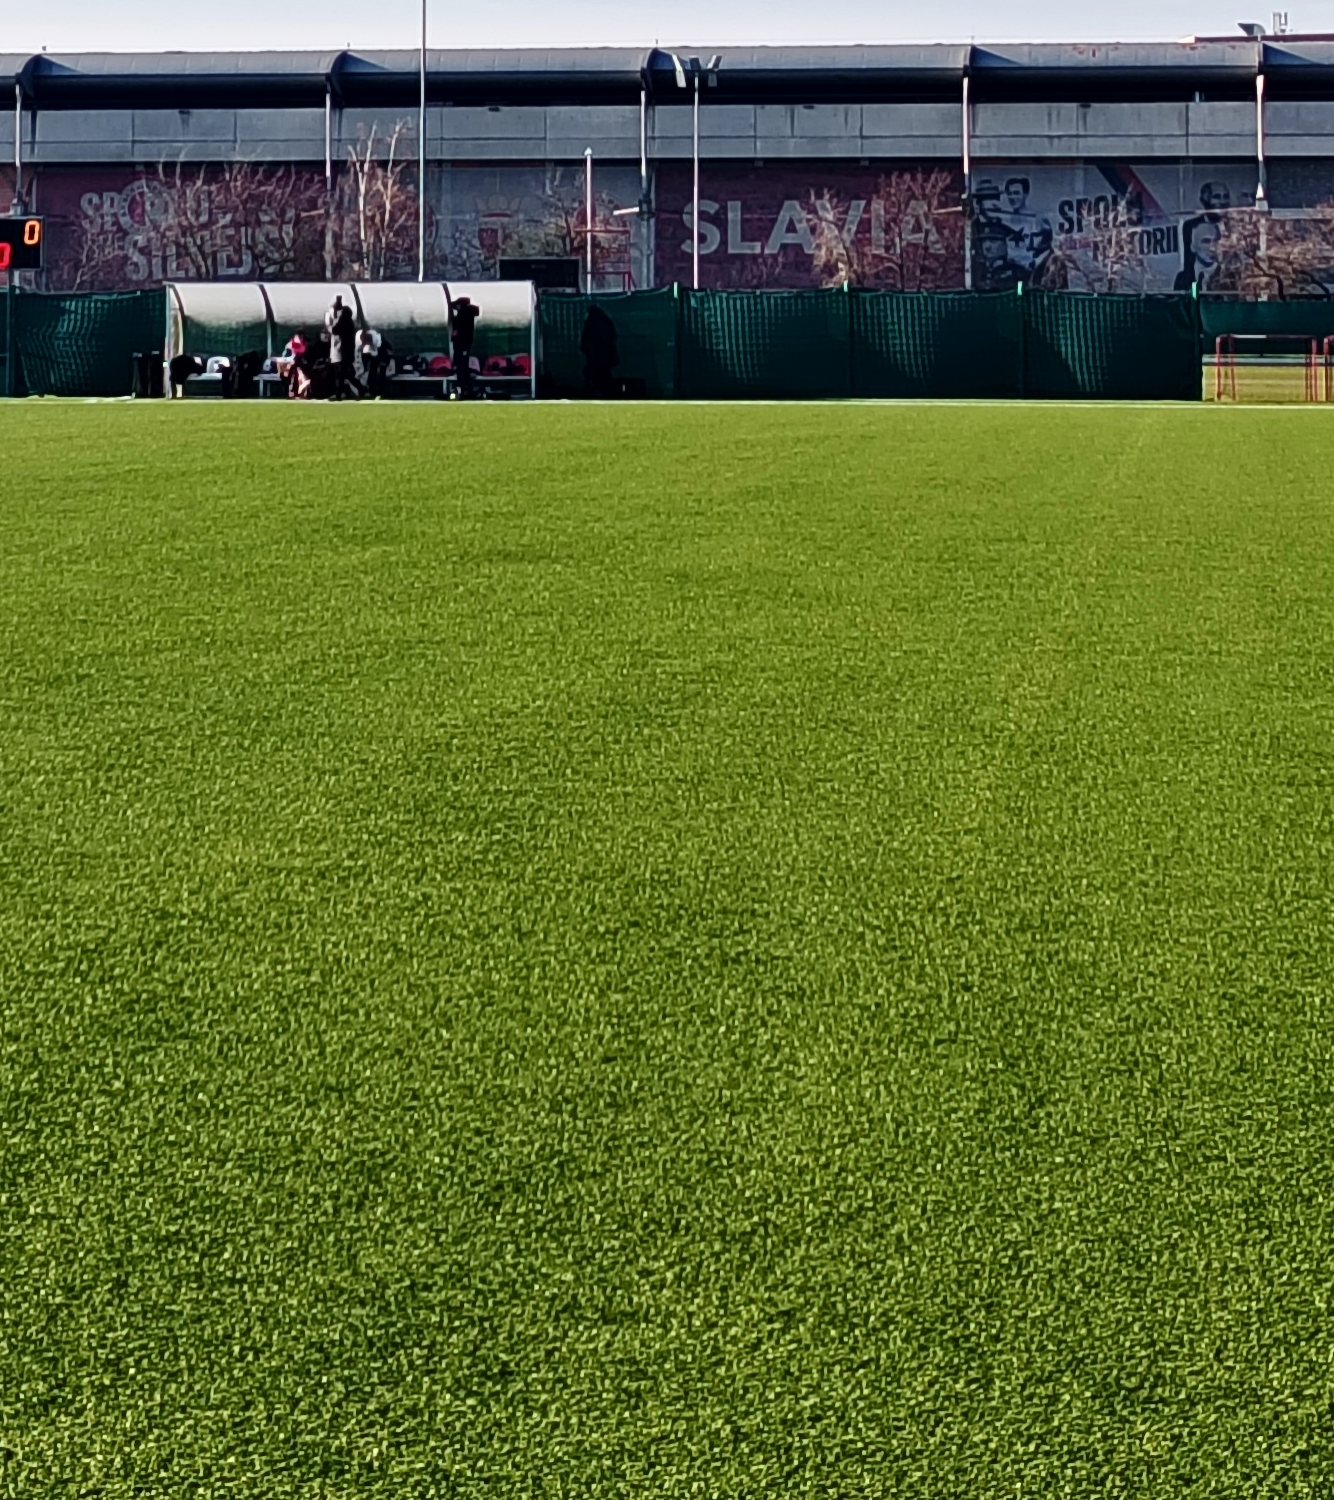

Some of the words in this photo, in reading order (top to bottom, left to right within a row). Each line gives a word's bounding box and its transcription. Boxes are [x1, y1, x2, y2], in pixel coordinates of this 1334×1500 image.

[23, 220, 40, 246] 0
[680, 200, 946, 255] SLAVIA
[1092, 225, 1179, 267] HTORII
